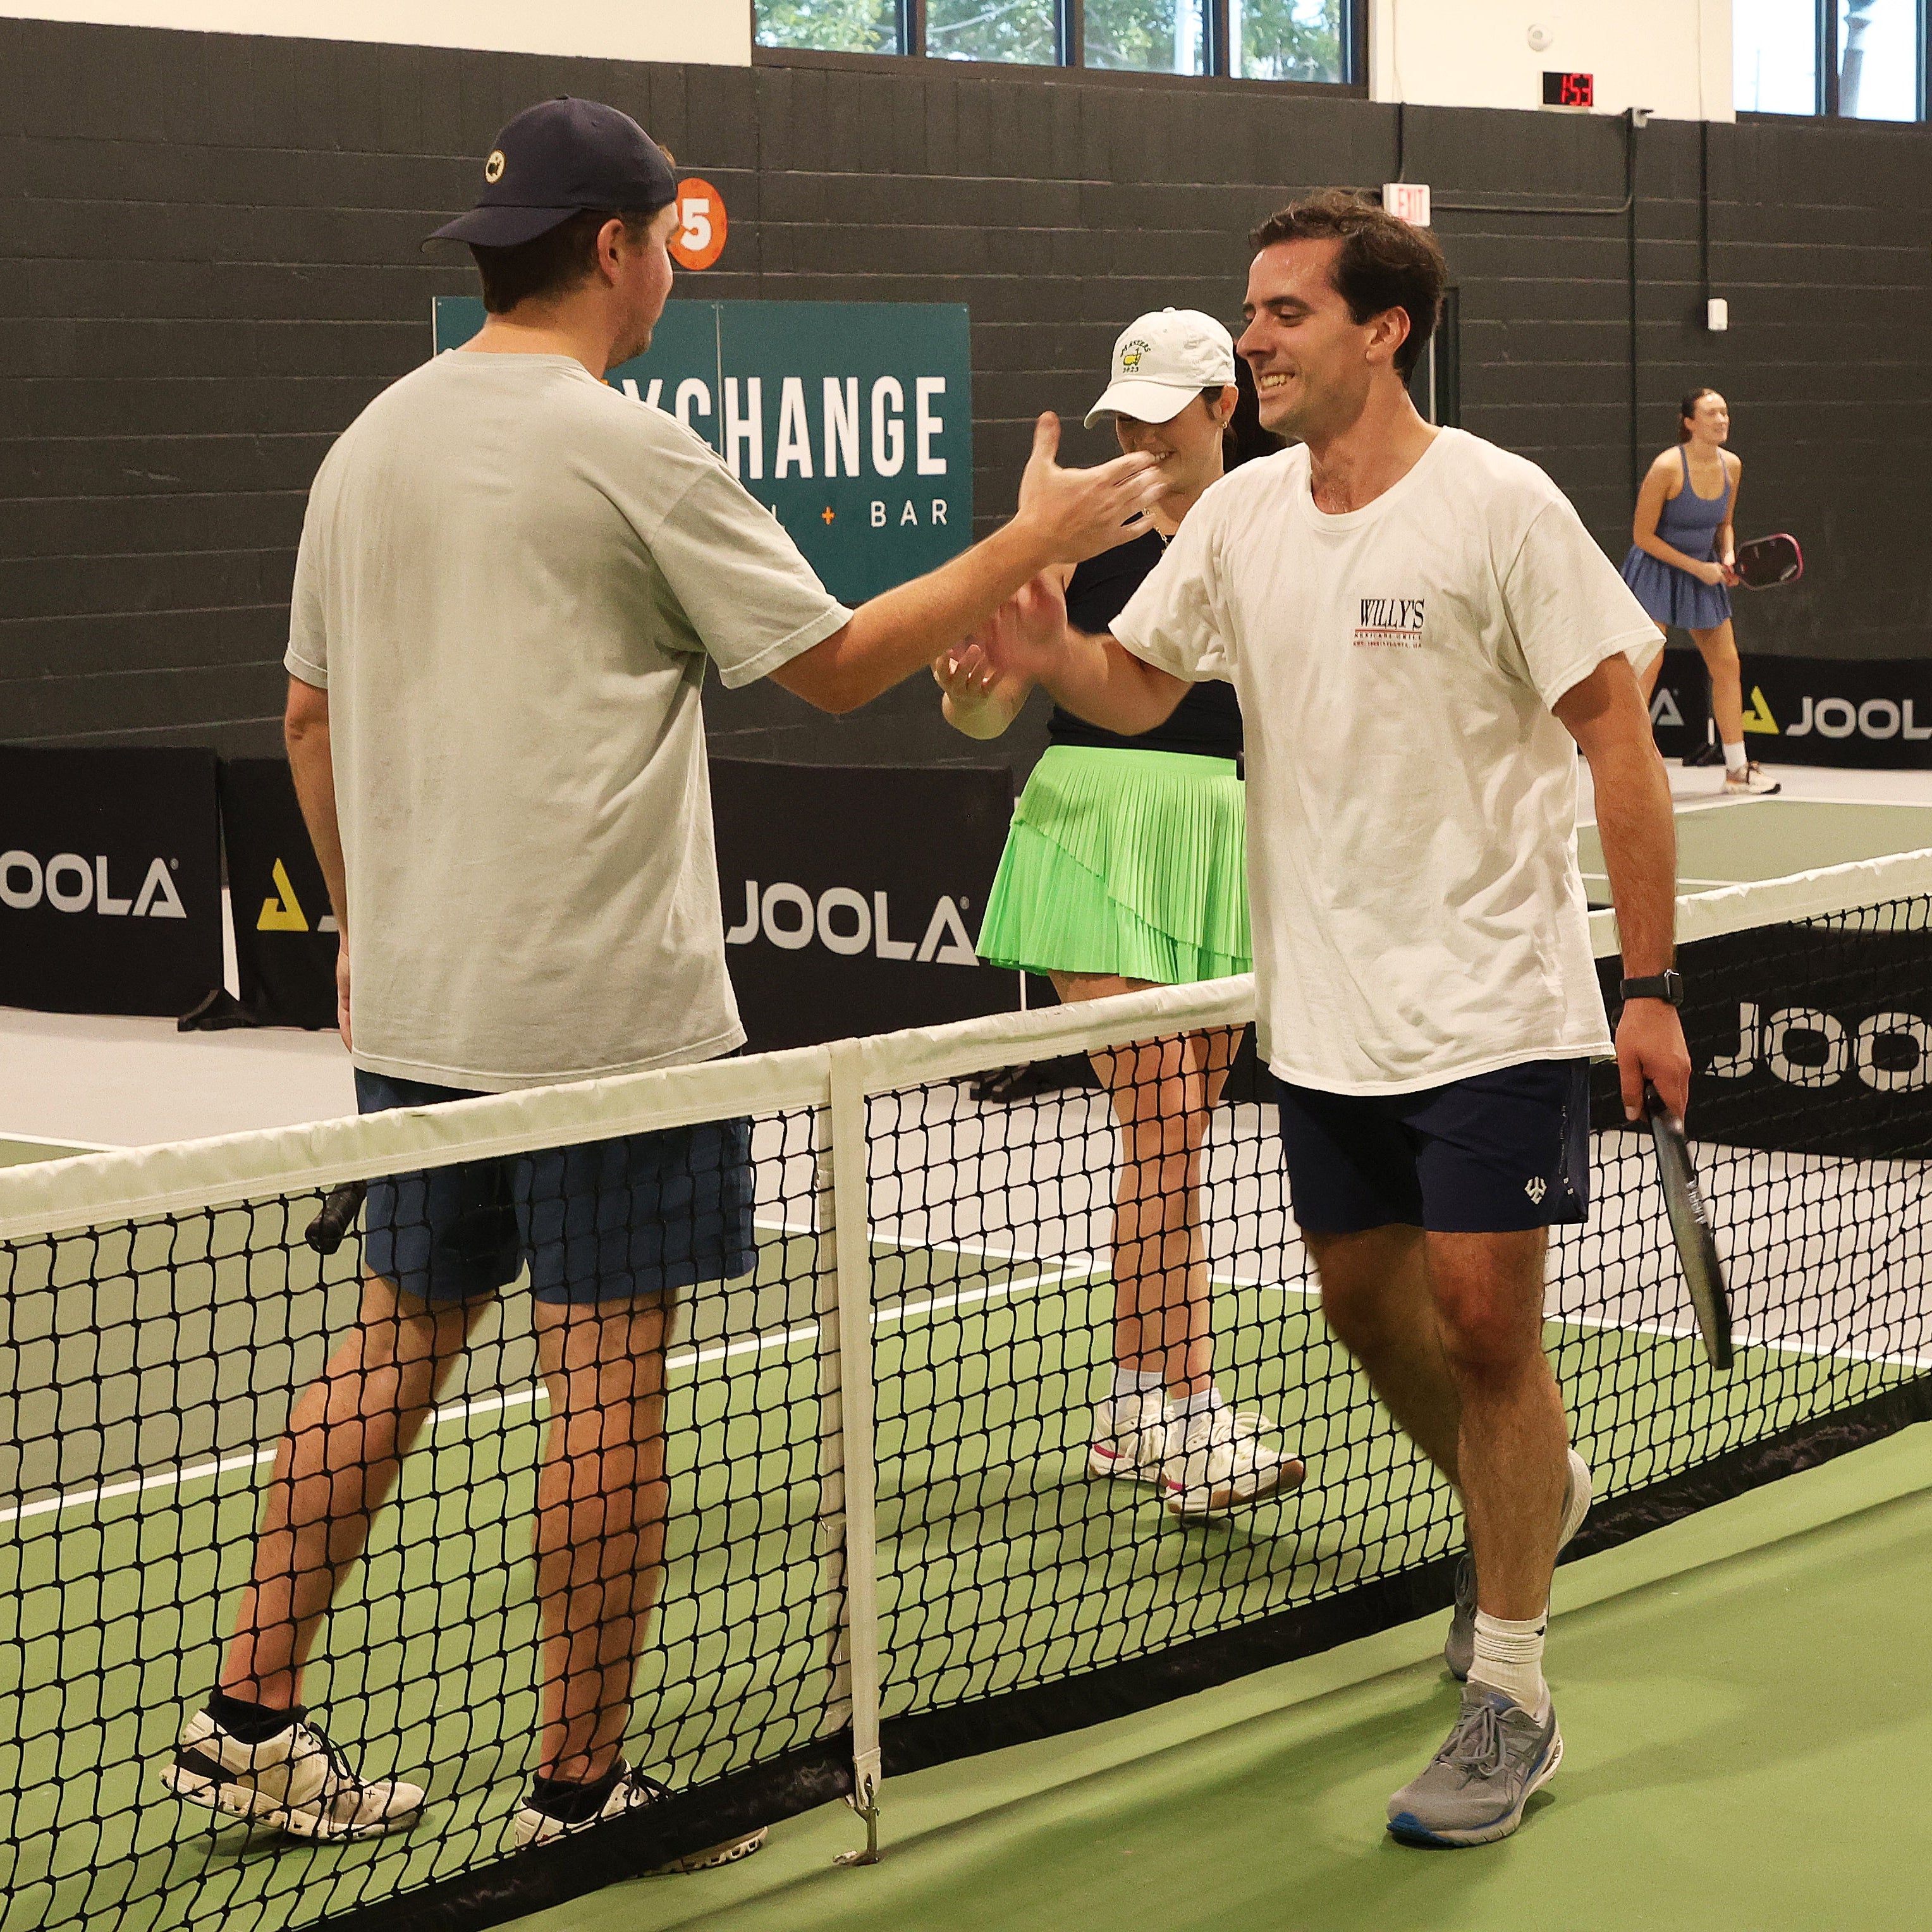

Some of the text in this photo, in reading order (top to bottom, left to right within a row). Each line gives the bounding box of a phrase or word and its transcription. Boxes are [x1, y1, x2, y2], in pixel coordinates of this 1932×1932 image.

[1398, 187, 1423, 223] EXIT
[680, 198, 712, 251] 5
[870, 498, 947, 527] BAR
[1360, 598, 1424, 630] WILLY'S
[726, 879, 980, 966] JOOLA
